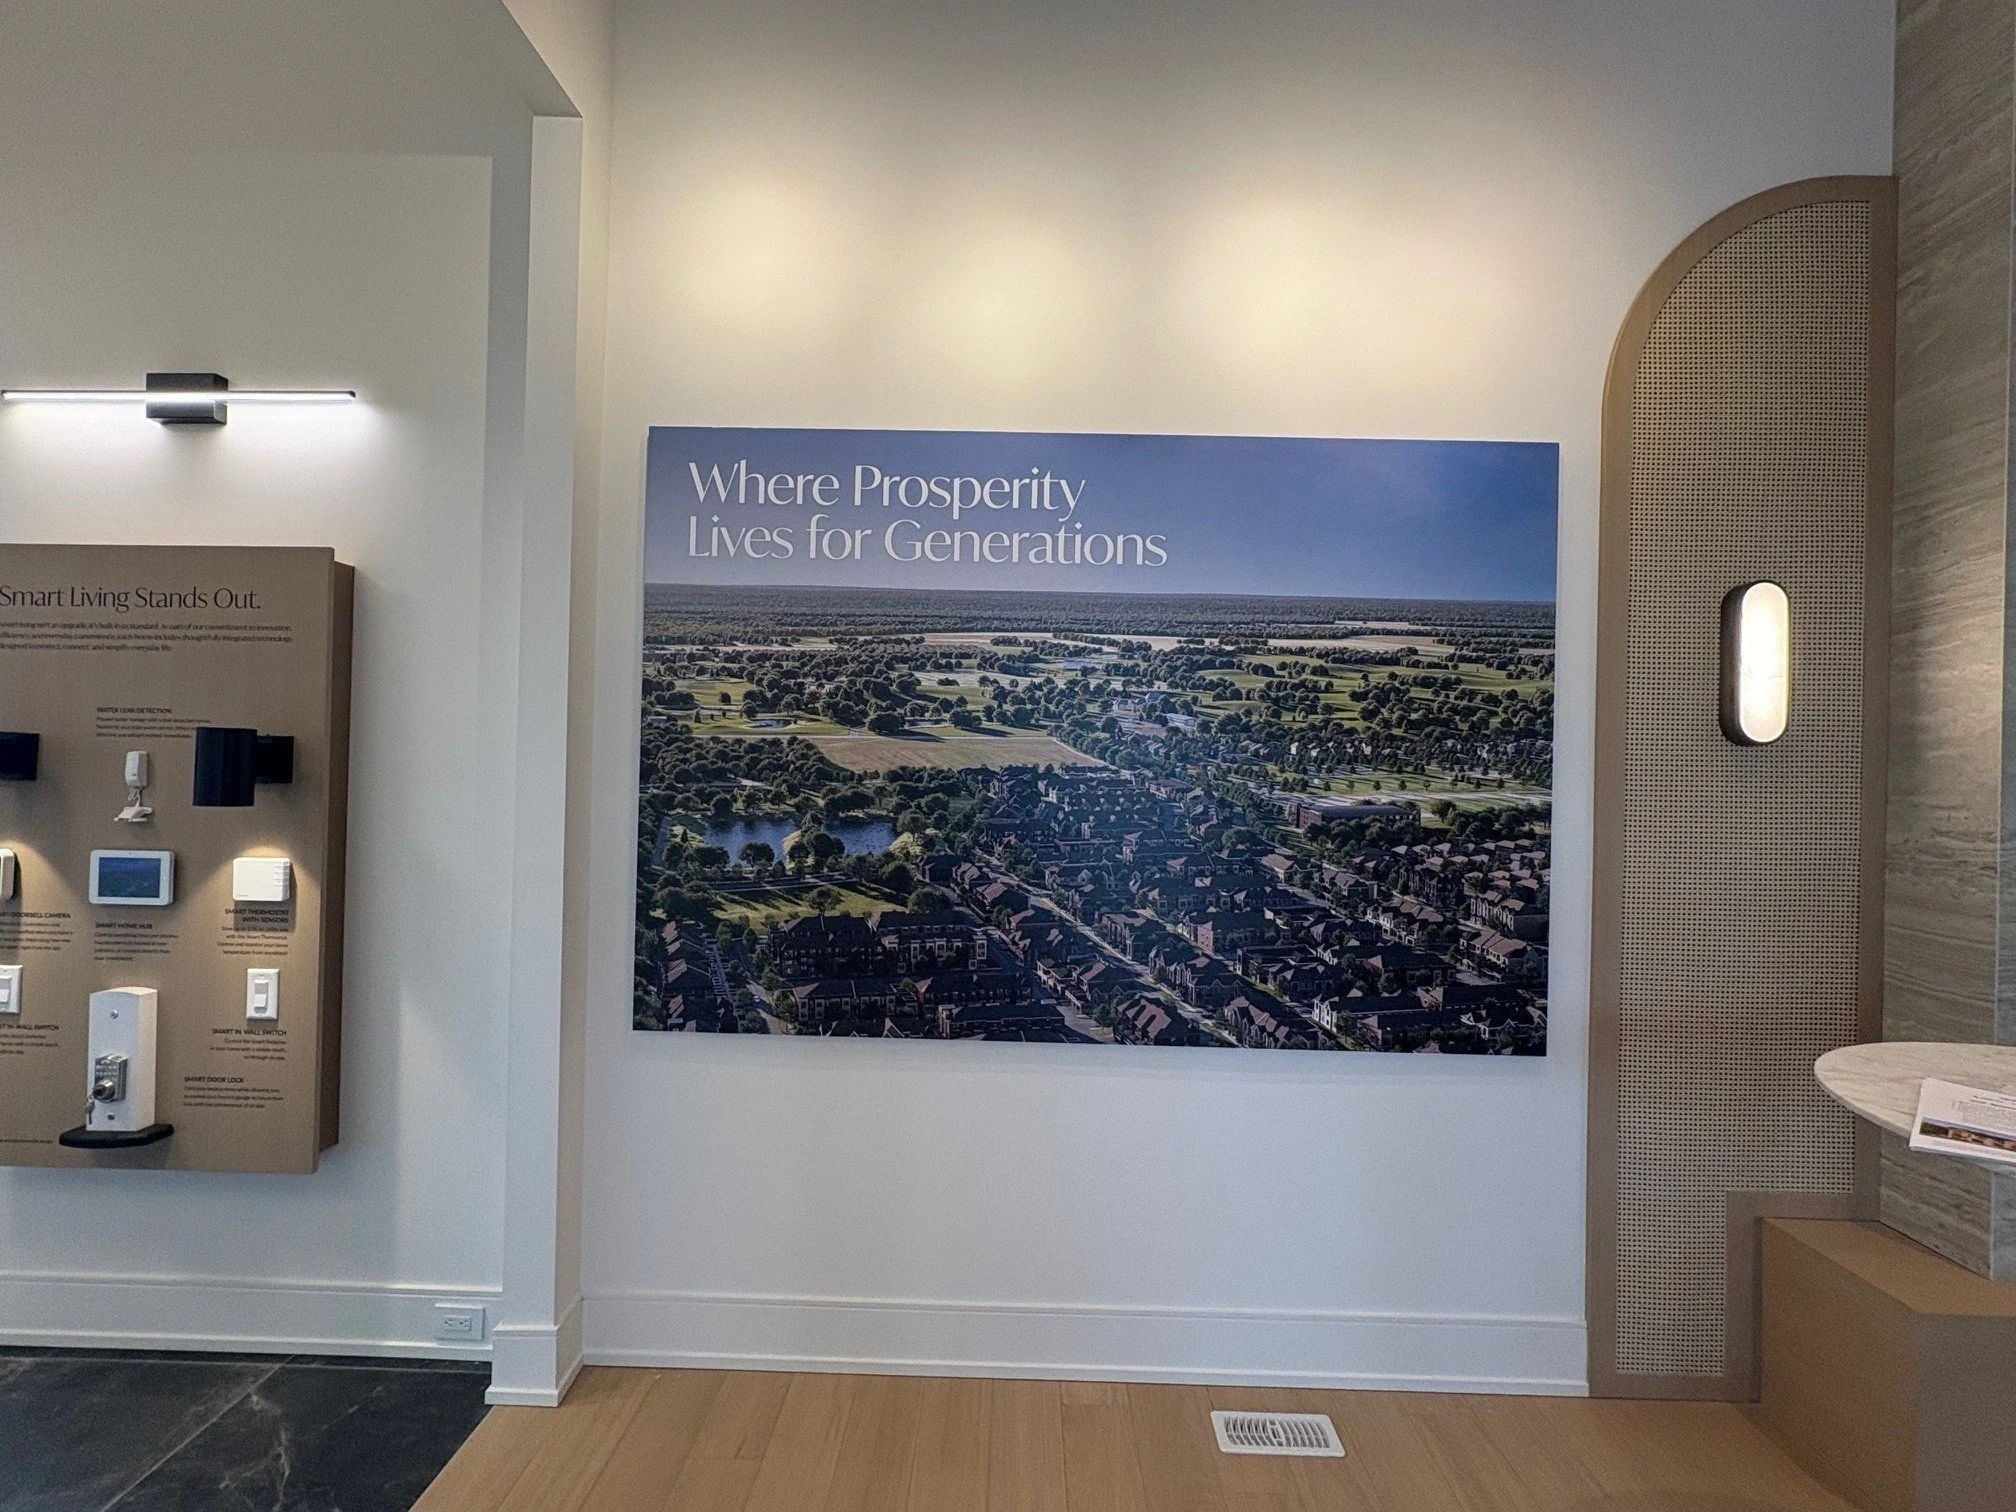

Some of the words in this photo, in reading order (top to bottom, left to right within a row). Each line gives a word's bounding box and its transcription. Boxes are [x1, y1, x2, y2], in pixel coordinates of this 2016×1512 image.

[688, 460, 840, 507] Where
[853, 465, 1086, 522] Prosperity
[688, 514, 794, 558] Lives
[806, 514, 872, 561] for
[884, 519, 1168, 567] Generations
[0, 585, 65, 607] Smart
[70, 587, 130, 613] Living
[135, 586, 208, 609] Stands
[214, 588, 261, 609] Out.
